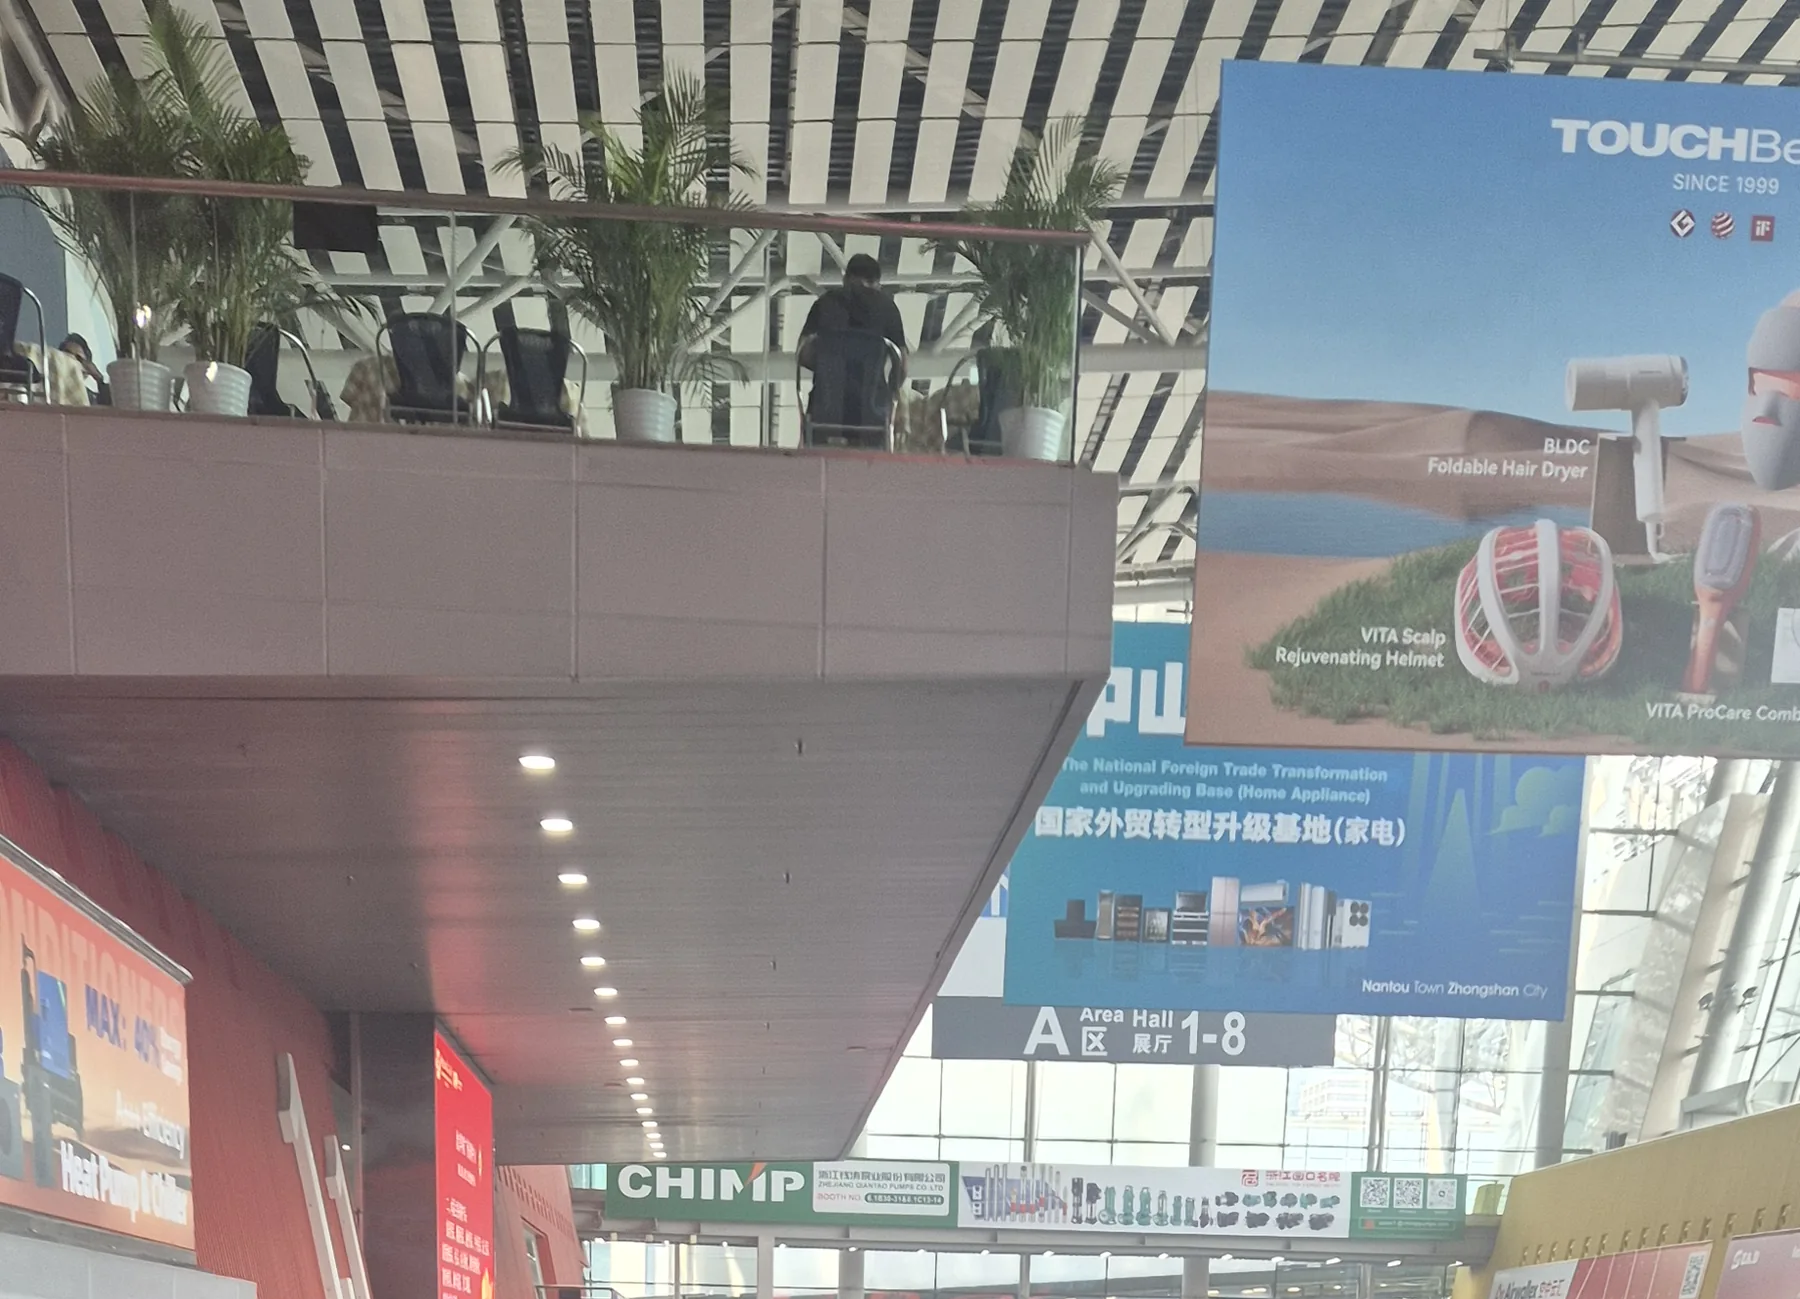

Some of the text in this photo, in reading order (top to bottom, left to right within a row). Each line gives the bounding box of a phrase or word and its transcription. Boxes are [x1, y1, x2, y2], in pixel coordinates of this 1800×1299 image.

[1673, 173, 1779, 195] SINCE 1999
[1543, 437, 1590, 455] BLDC
[1427, 457, 1588, 482] Foldable Hair Dryer
[1361, 626, 1446, 648] VITA Scalp
[1275, 646, 1445, 670] Rejuvenating Helmet
[1646, 702, 1683, 719] VITA
[1687, 703, 1752, 721] ProCare
[1093, 759, 1157, 774] National
[1161, 760, 1218, 778] Foreign
[1222, 762, 1267, 778] Trade
[1272, 764, 1388, 782] Transformation
[1080, 780, 1371, 805] and Upgrading Base (Home Appliance)
[1034, 805, 1406, 846] 国家外贸转型升级基地(家电)
[1362, 979, 1548, 998] Nantou Town Zhongshan City
[1023, 1006, 1246, 1056] A Area Hall 1-8
[1081, 1026, 1172, 1056] 区 展厅
[60, 1140, 101, 1201] Heat
[618, 1161, 806, 1202] CHIMP
